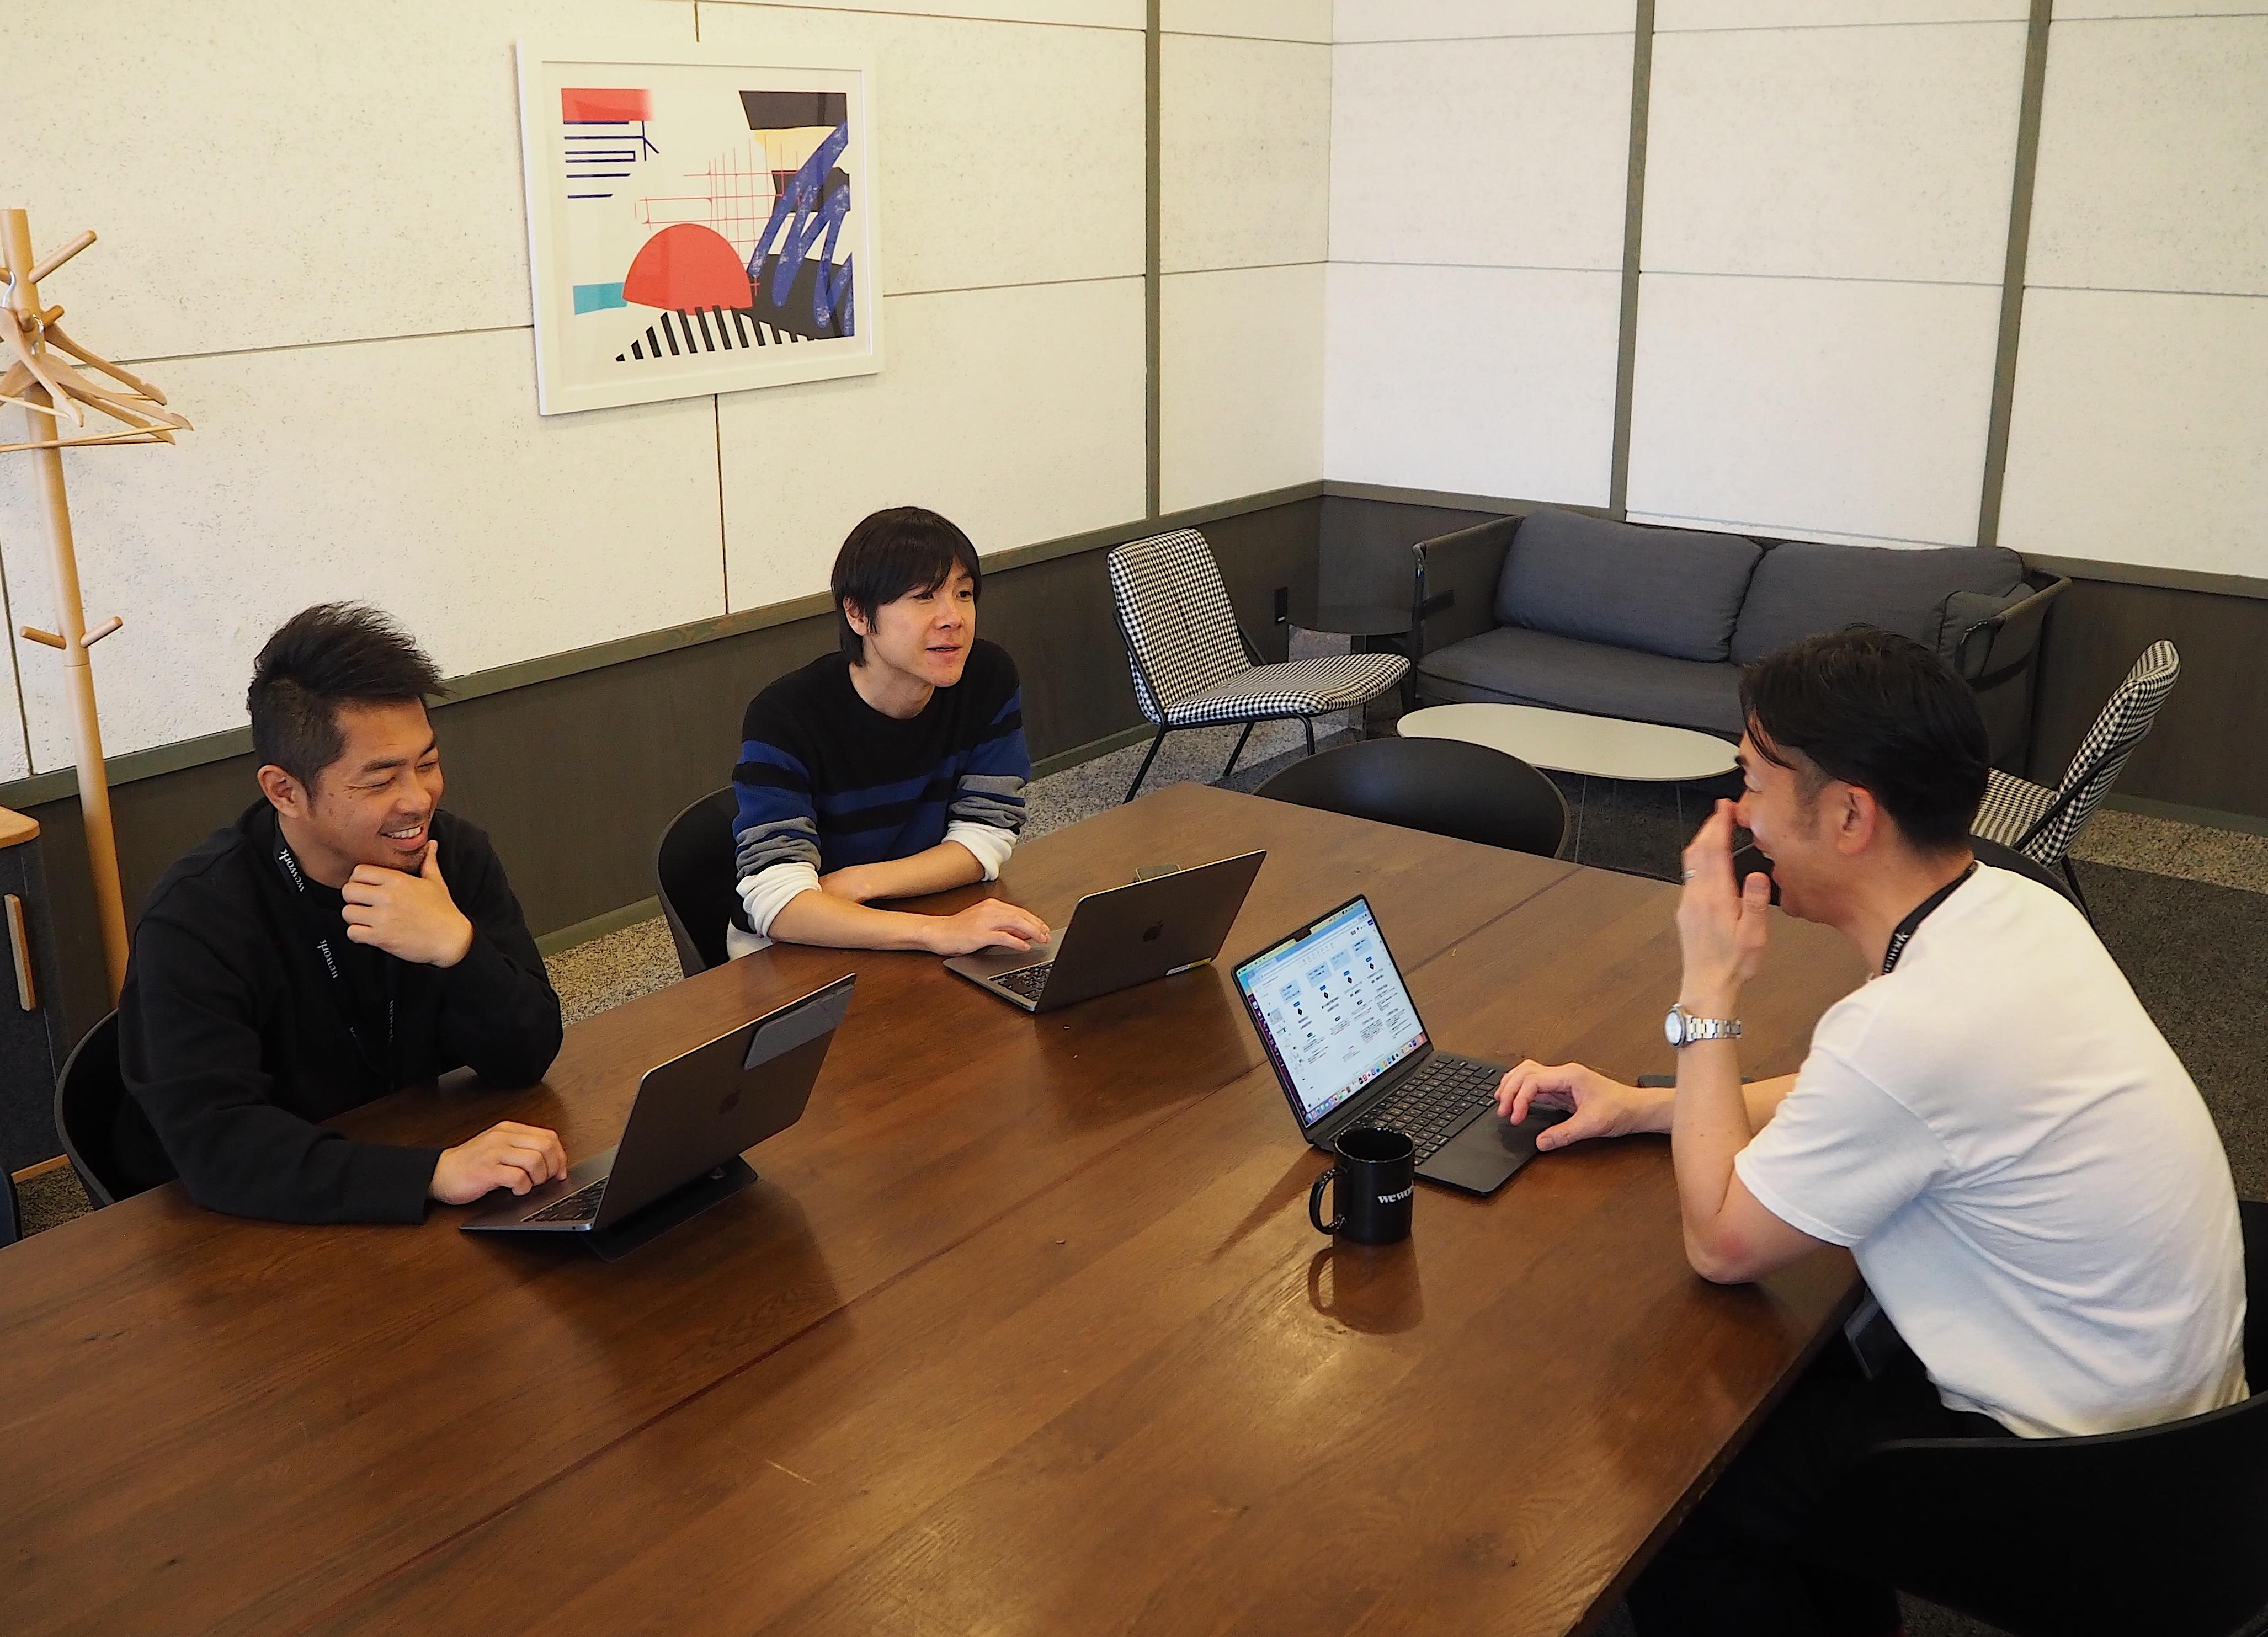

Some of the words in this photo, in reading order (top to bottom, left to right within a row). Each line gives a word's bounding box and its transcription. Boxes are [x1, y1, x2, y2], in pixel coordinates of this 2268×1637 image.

[278, 848, 305, 893] wework
[317, 939, 338, 979] wework
[1377, 1179, 1414, 1204] wewo
